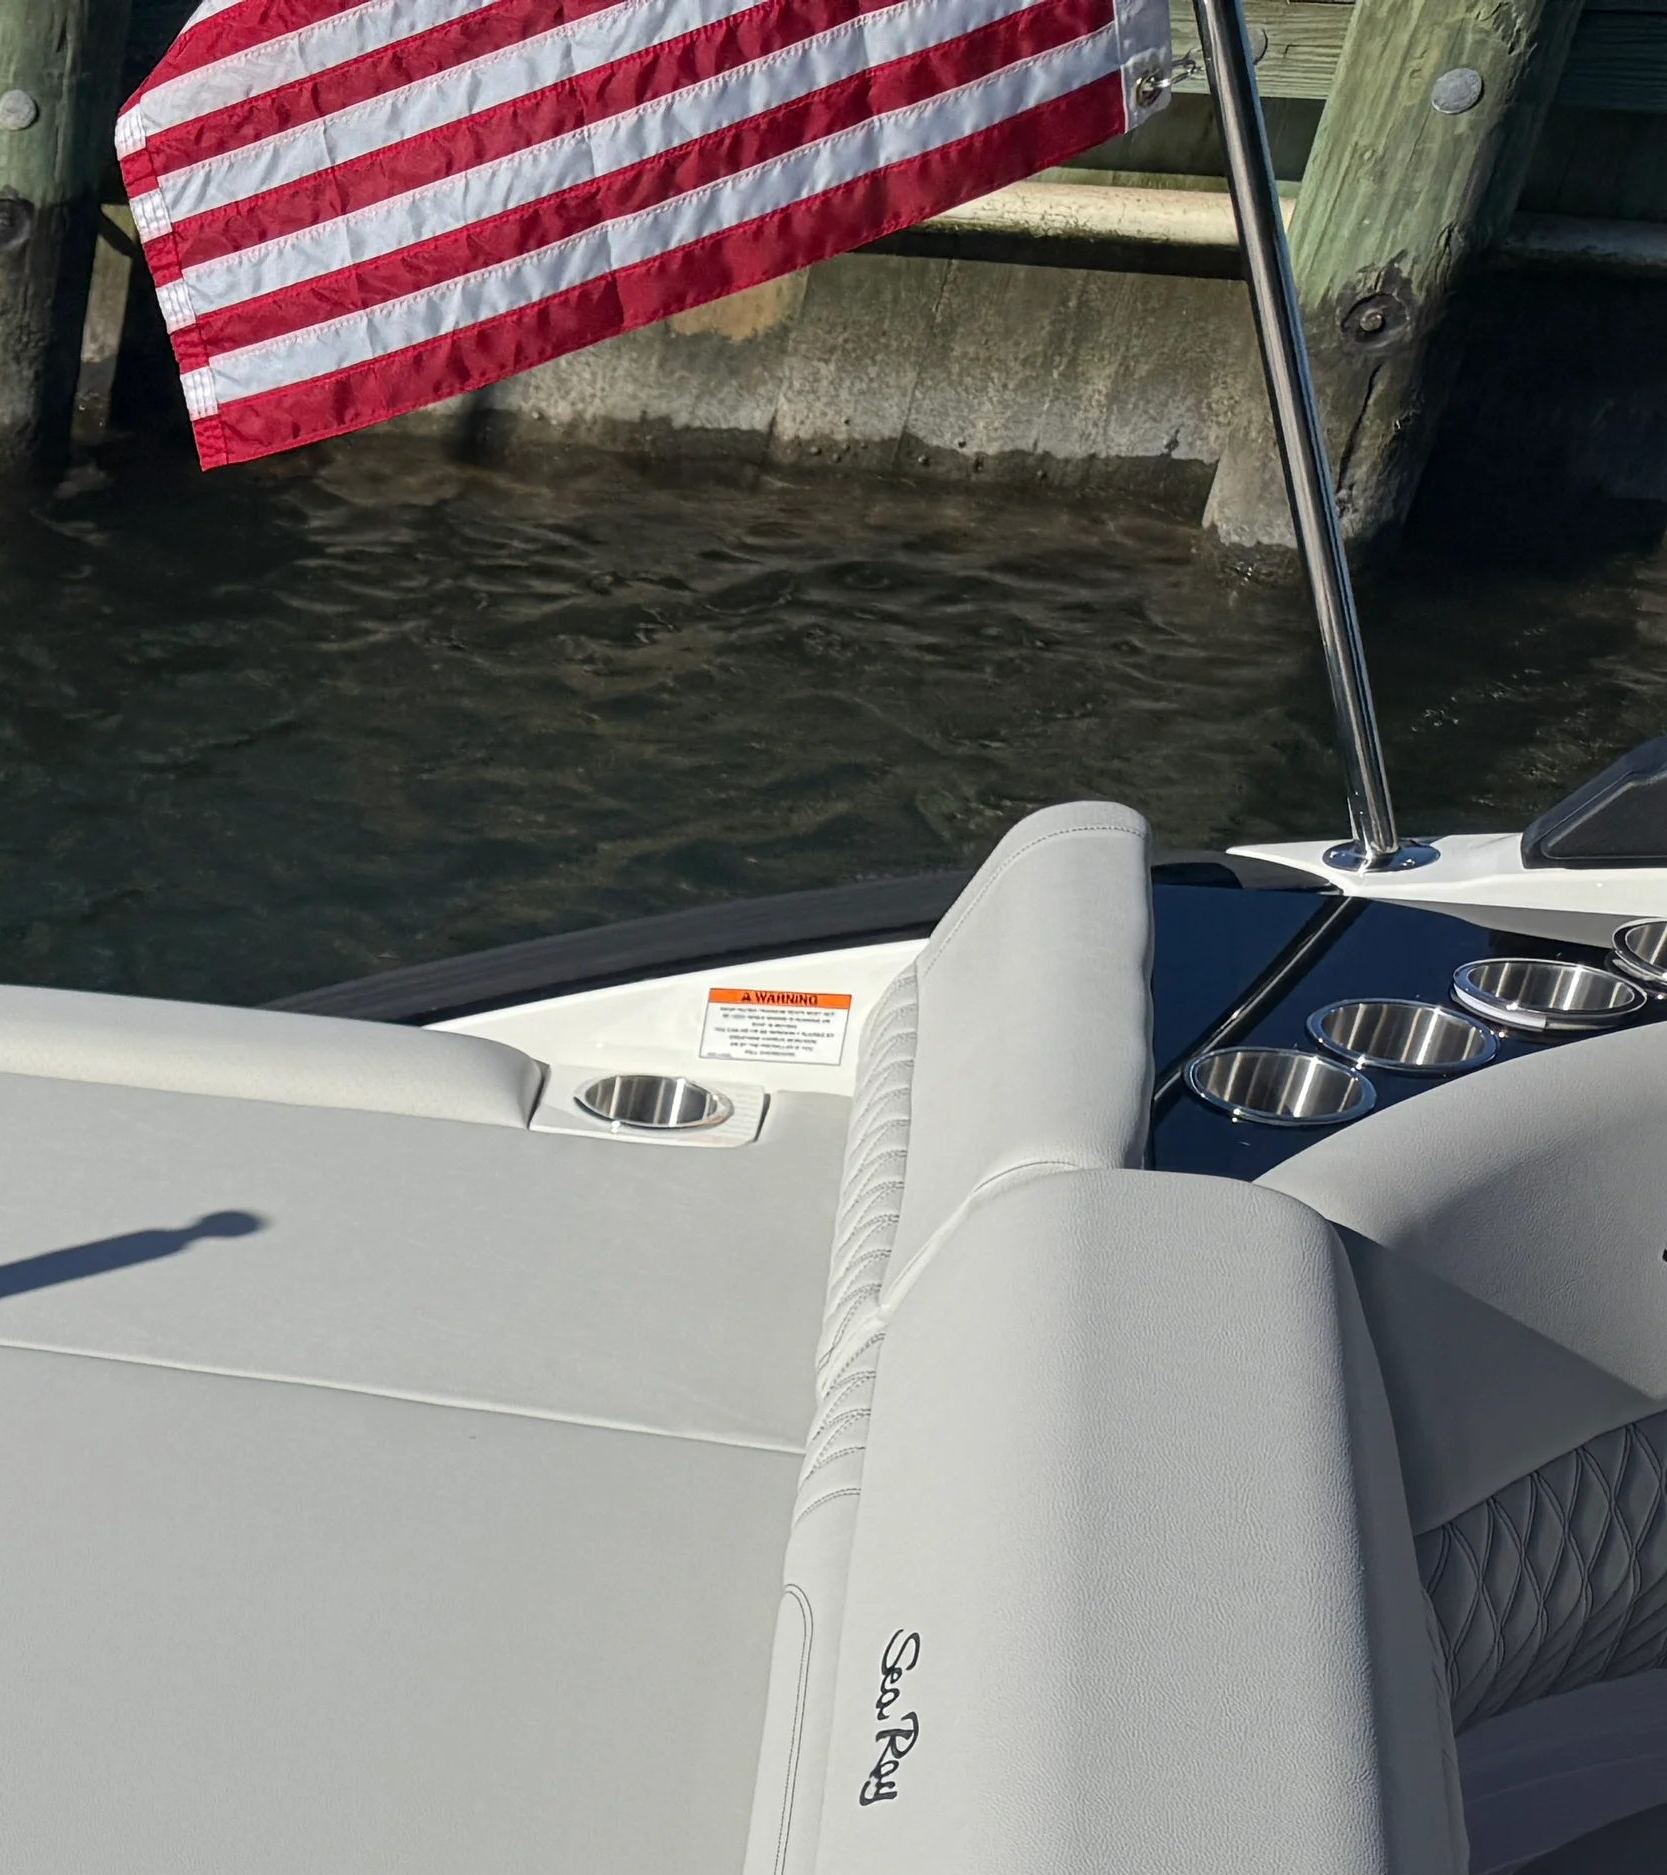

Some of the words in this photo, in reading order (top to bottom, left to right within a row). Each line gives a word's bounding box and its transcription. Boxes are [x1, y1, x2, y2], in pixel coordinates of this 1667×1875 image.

[755, 990, 818, 1006] WARNING
[875, 1628, 921, 1721] Sea
[858, 1710, 919, 1807] Ray
